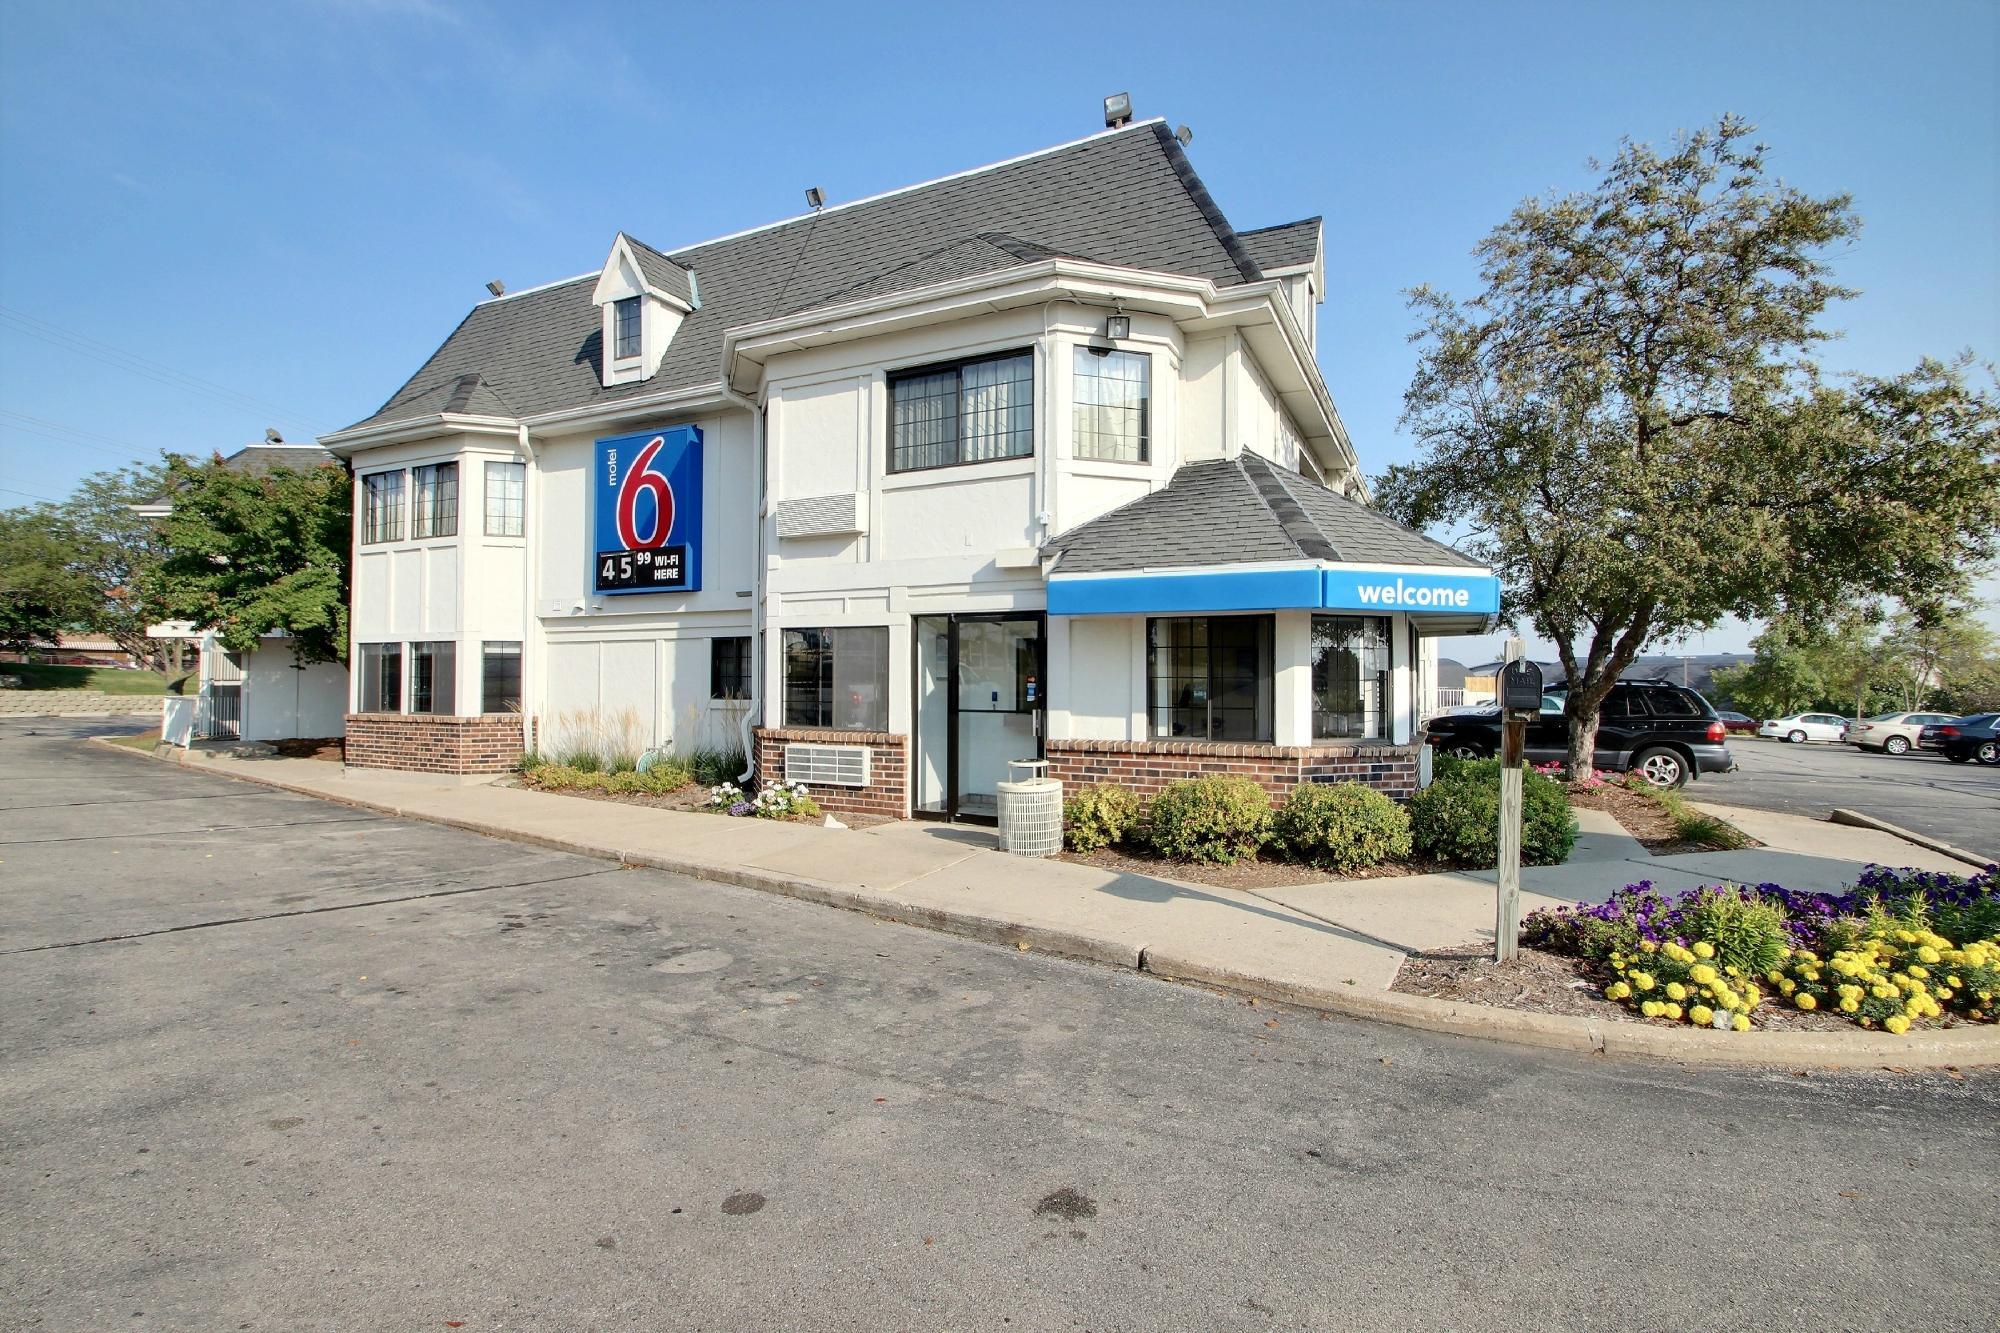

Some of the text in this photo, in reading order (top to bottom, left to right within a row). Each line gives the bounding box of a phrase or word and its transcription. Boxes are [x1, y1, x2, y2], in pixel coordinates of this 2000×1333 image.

[607, 436, 676, 551] motel 6
[654, 554, 679, 567] WI-FI
[654, 568, 679, 581] HERE
[1357, 578, 1470, 607] welcome
